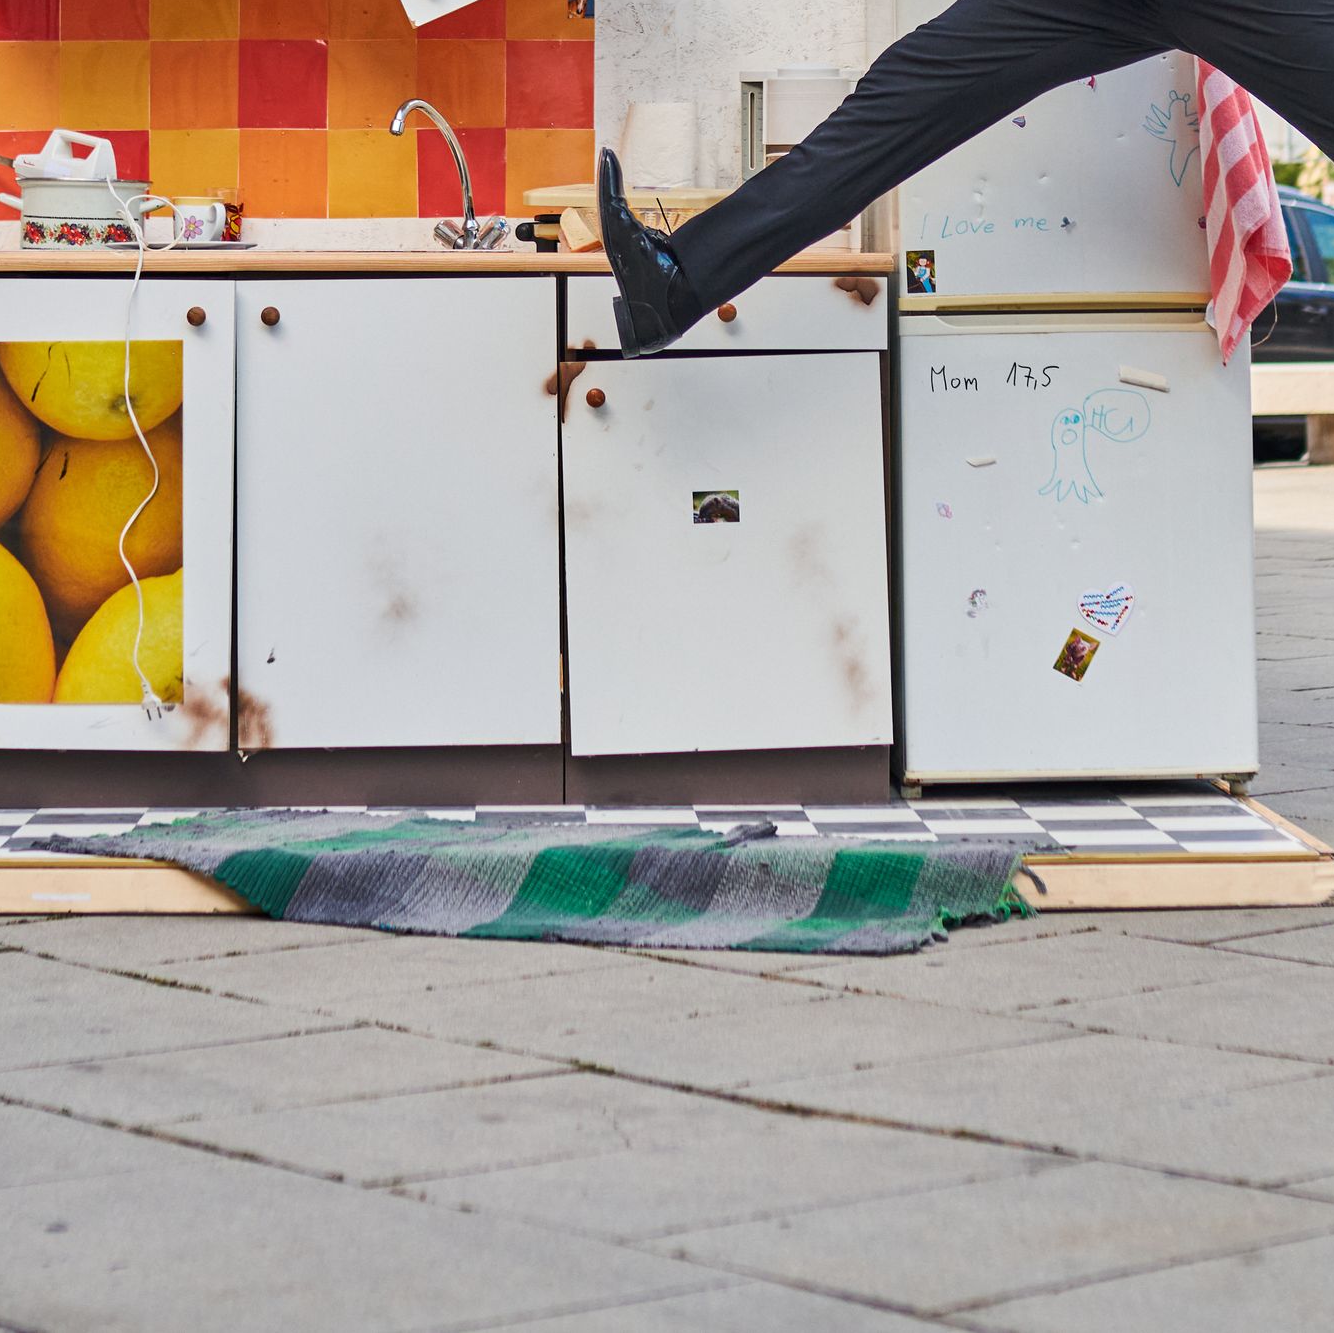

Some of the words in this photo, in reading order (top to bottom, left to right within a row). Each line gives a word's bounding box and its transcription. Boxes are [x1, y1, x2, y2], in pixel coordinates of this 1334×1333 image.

[1014, 217, 1051, 231] me
[930, 365, 978, 392] Mom
[1006, 362, 1060, 391] 17,5
